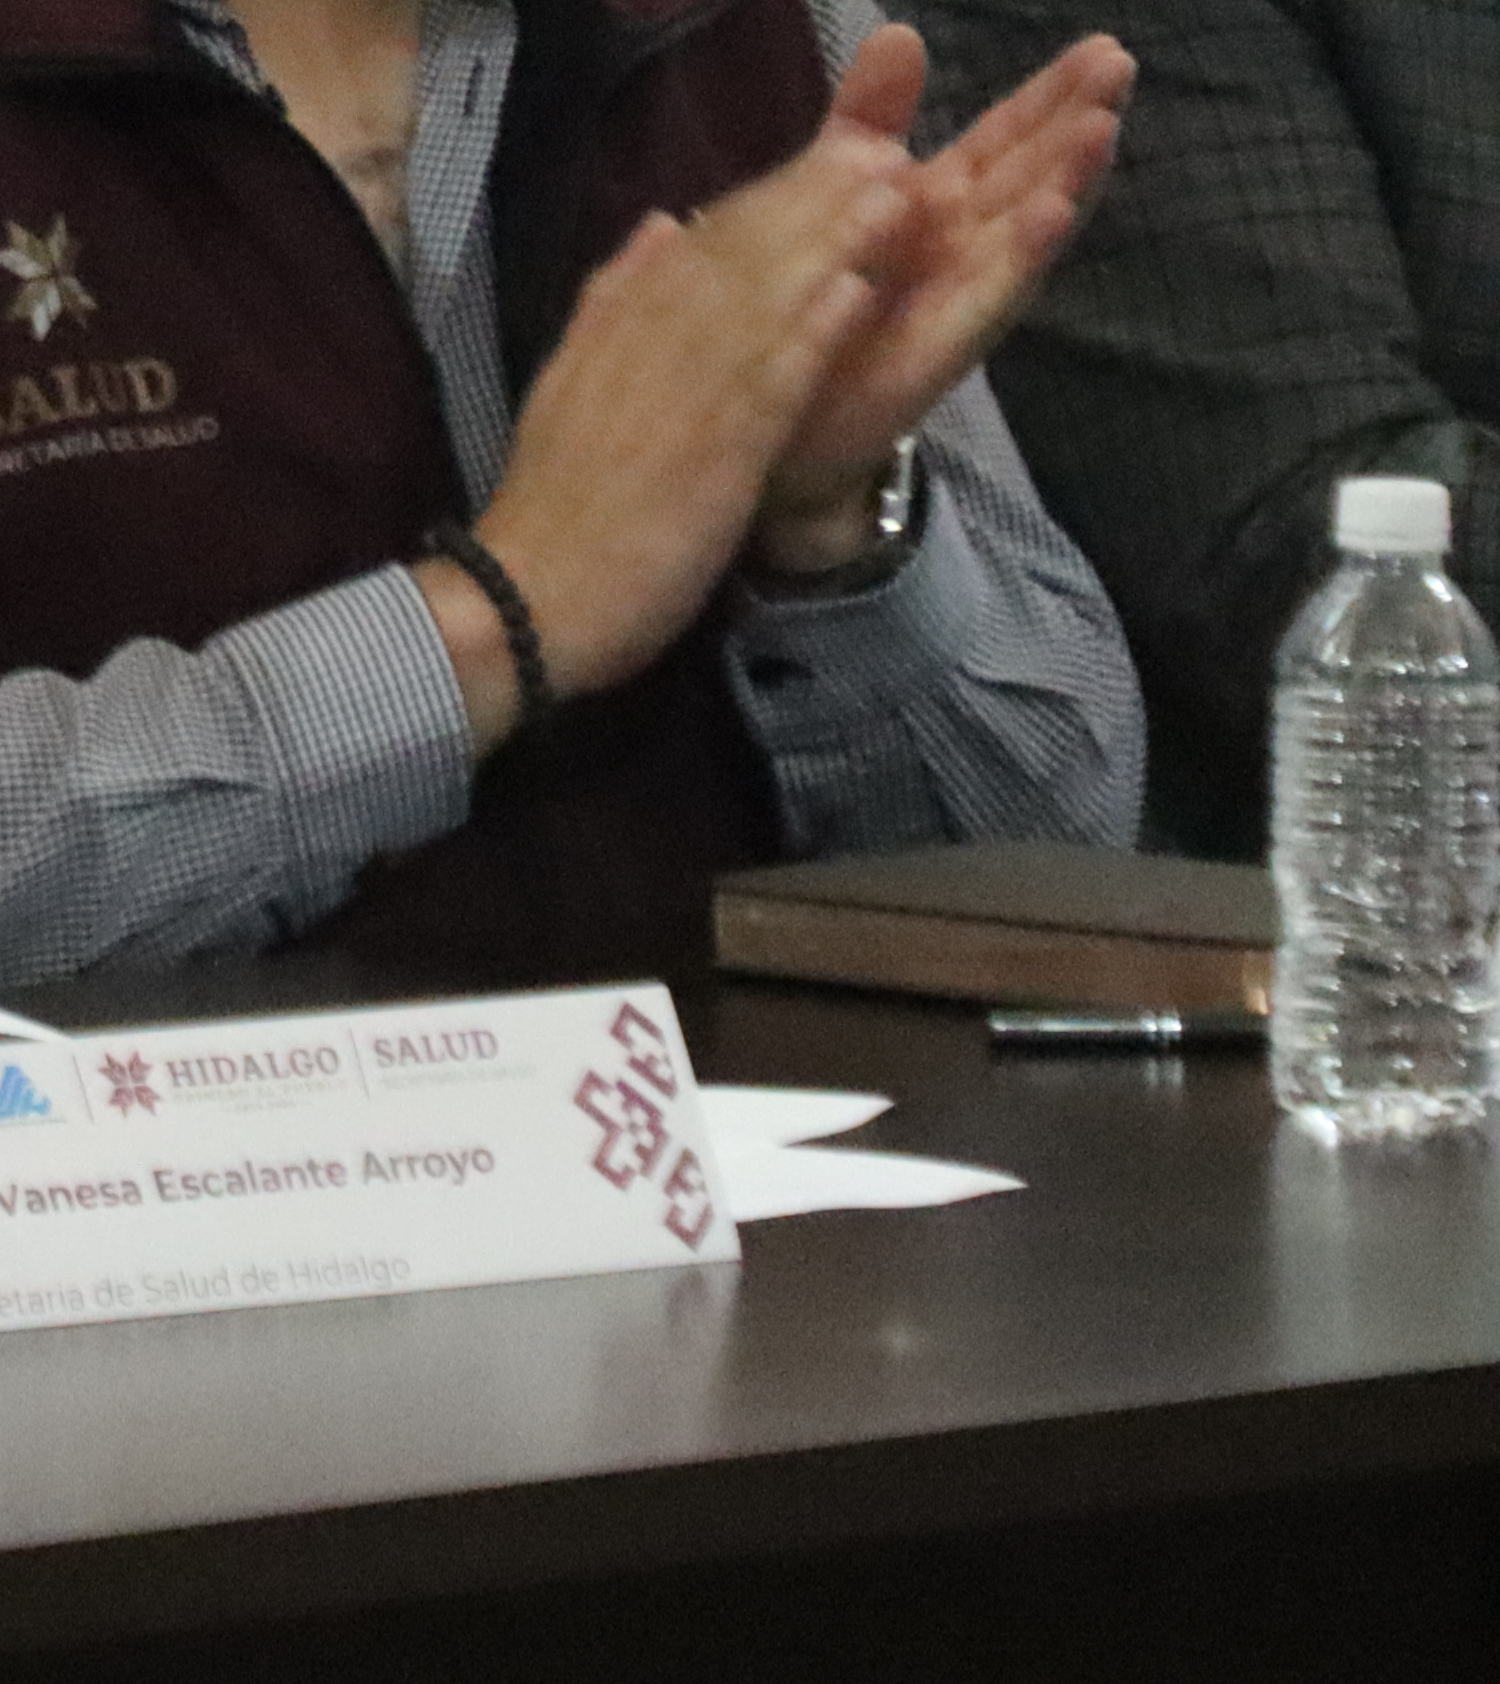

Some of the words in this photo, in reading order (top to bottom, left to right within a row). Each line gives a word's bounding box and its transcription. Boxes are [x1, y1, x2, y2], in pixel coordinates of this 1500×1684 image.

[166, 1046, 340, 1088] HIDALGO
[373, 1029, 498, 1068] SALUD
[153, 1158, 347, 1204] Escalante
[361, 1142, 496, 1186] Arroyo
[94, 1281, 134, 1306] de
[142, 1268, 232, 1304] Salud
[241, 1264, 278, 1293] de
[287, 1254, 412, 1290] Hidalgo
